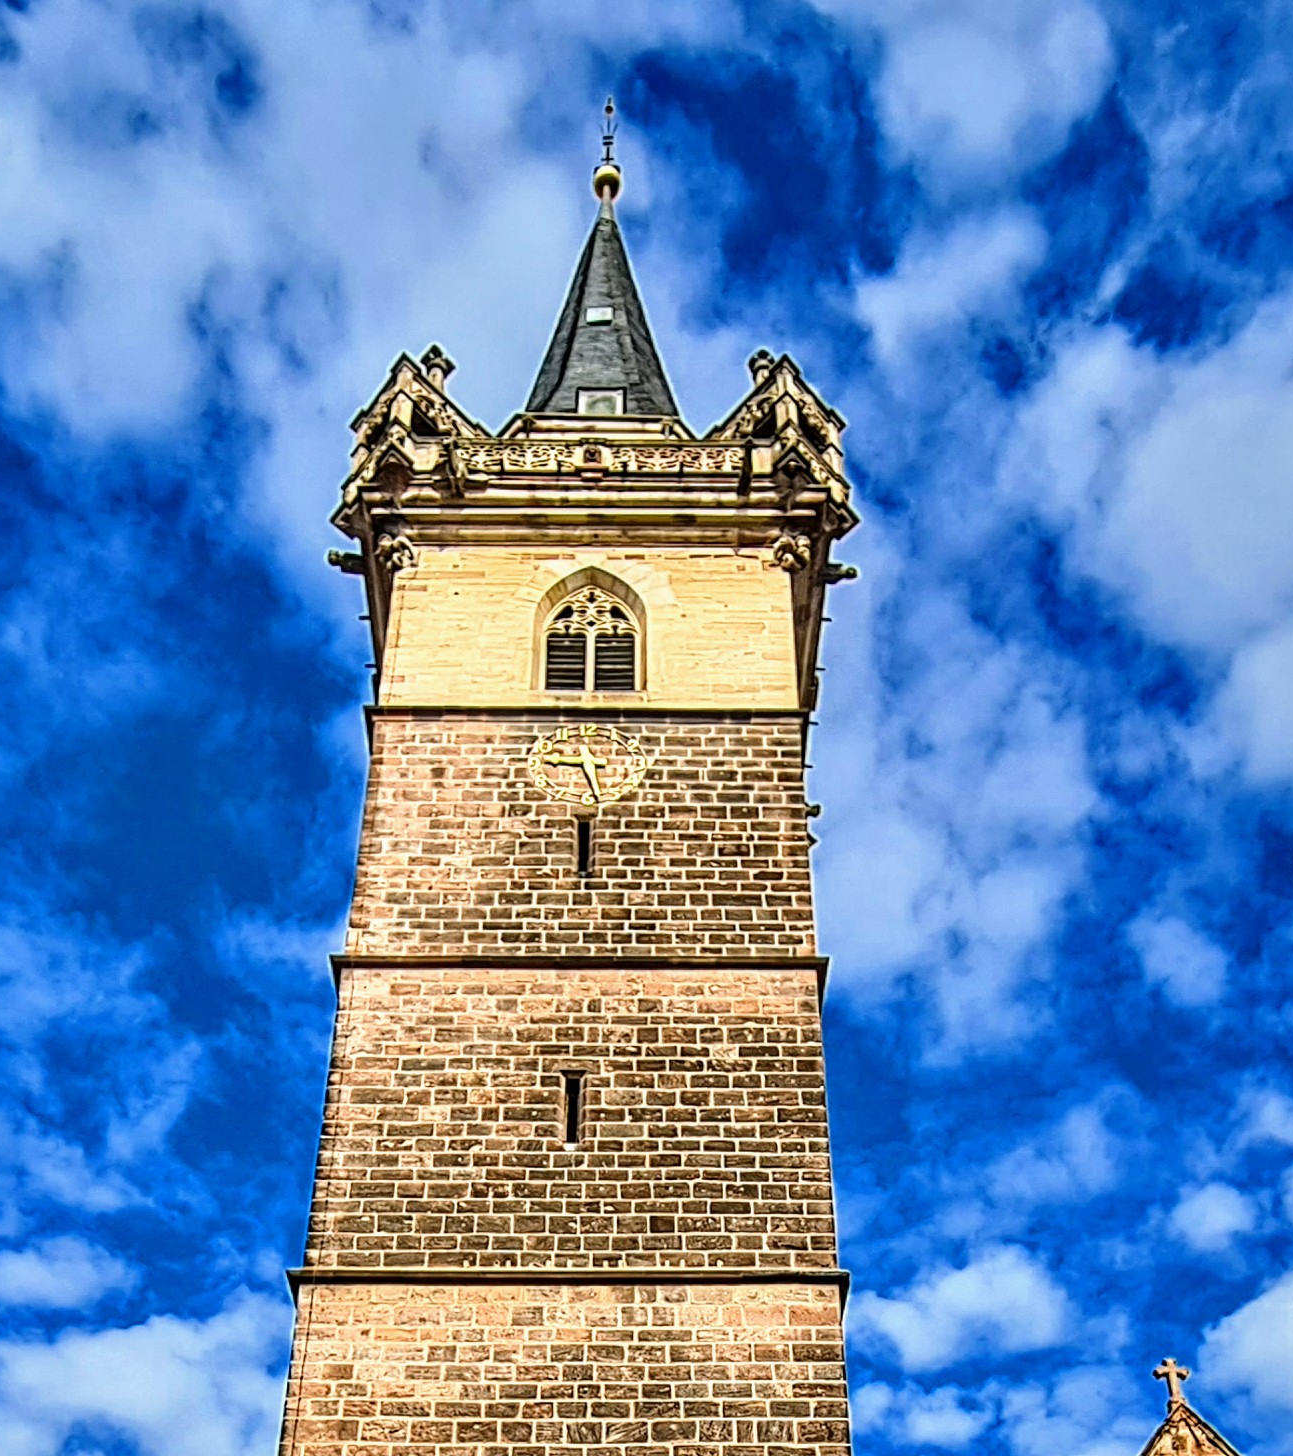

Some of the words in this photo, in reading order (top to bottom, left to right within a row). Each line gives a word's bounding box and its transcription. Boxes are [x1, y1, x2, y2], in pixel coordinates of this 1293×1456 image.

[555, 727, 569, 740] 11
[579, 723, 598, 737] 12
[533, 740, 553, 753] 10
[627, 739, 640, 752] 2
[581, 793, 595, 806] 6
